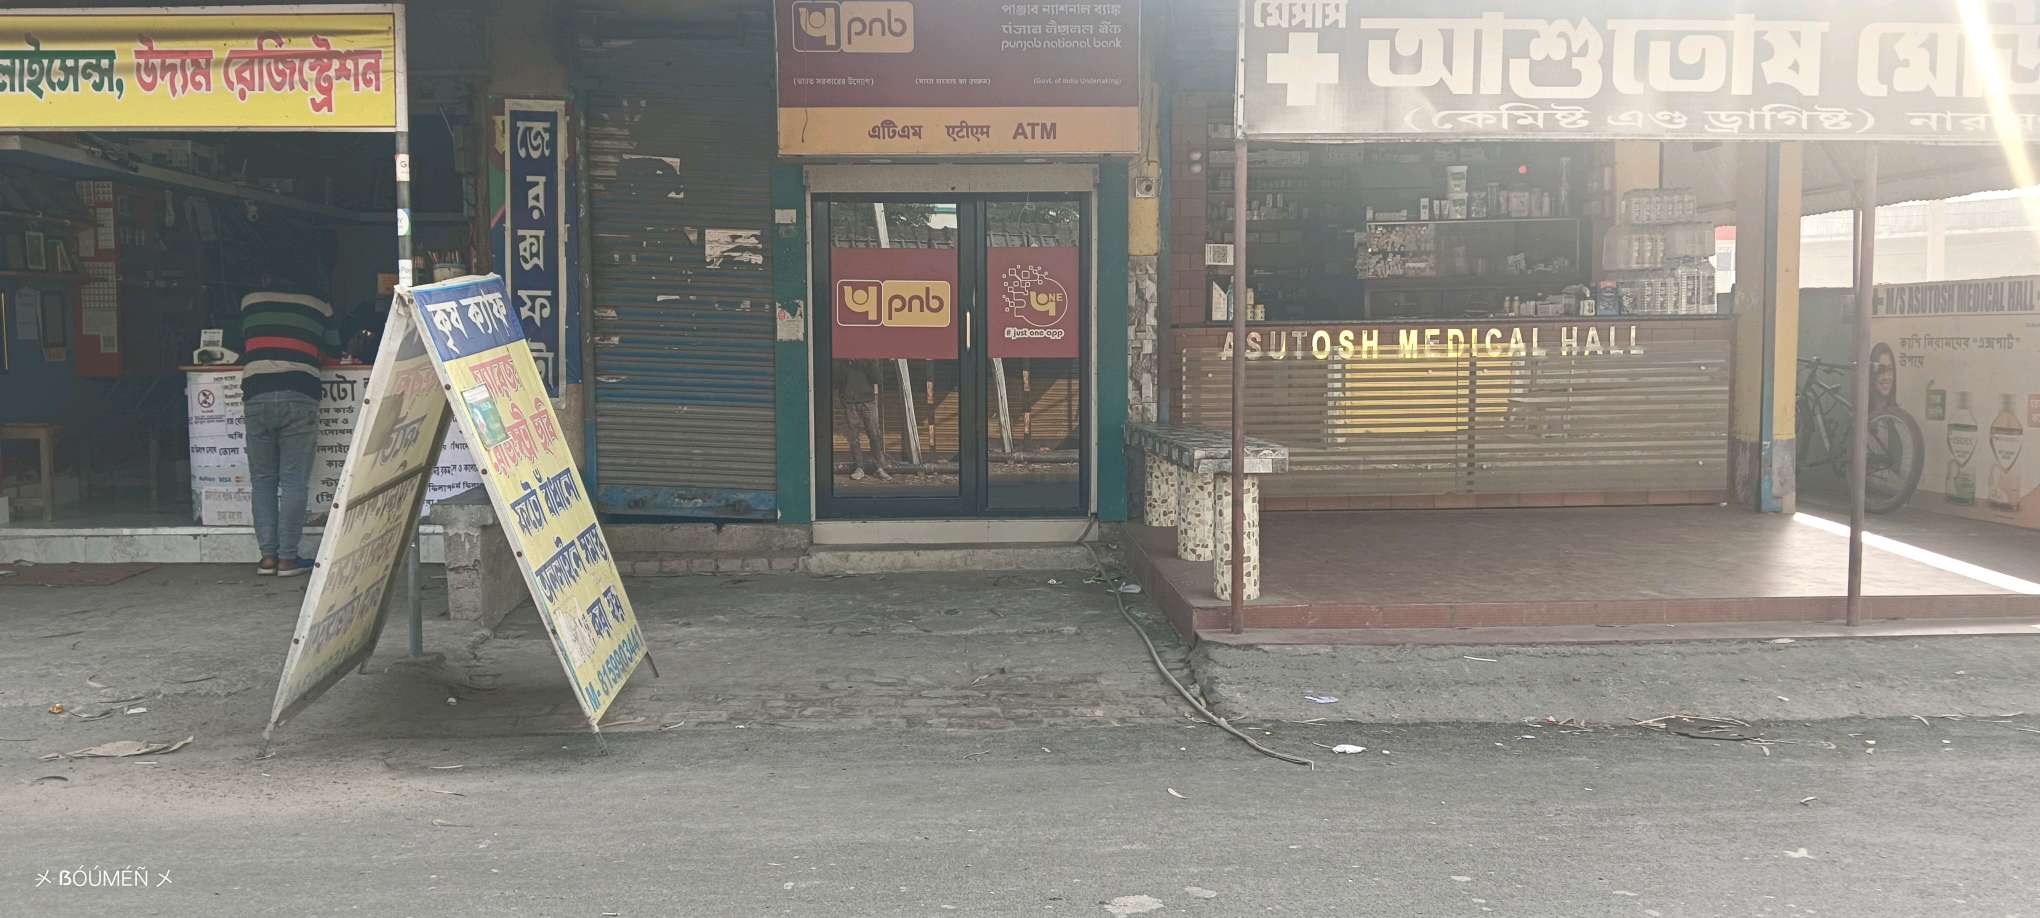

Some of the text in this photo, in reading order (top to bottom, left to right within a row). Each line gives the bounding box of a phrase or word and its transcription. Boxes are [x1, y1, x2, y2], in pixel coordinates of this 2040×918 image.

[847, 9, 908, 45] pnb
[1001, 37, 1122, 51] punjab national bank
[134, 36, 213, 98] উদ্যম
[1361, 12, 1829, 99] আশুতোষ
[868, 119, 924, 140] এটিএম
[945, 120, 991, 142] एटीएम
[1012, 122, 1057, 140] ATM
[888, 286, 945, 321] pnb
[1907, 283, 1957, 314] ASUTOSH
[1957, 280, 2005, 313] MEDICAL
[2008, 279, 2035, 312] HALL
[1013, 328, 1028, 338] just
[1046, 330, 1063, 339] app
[1221, 325, 1645, 360] ASUTOSH MEDICAL HALL
[510, 480, 547, 537] ফটো
